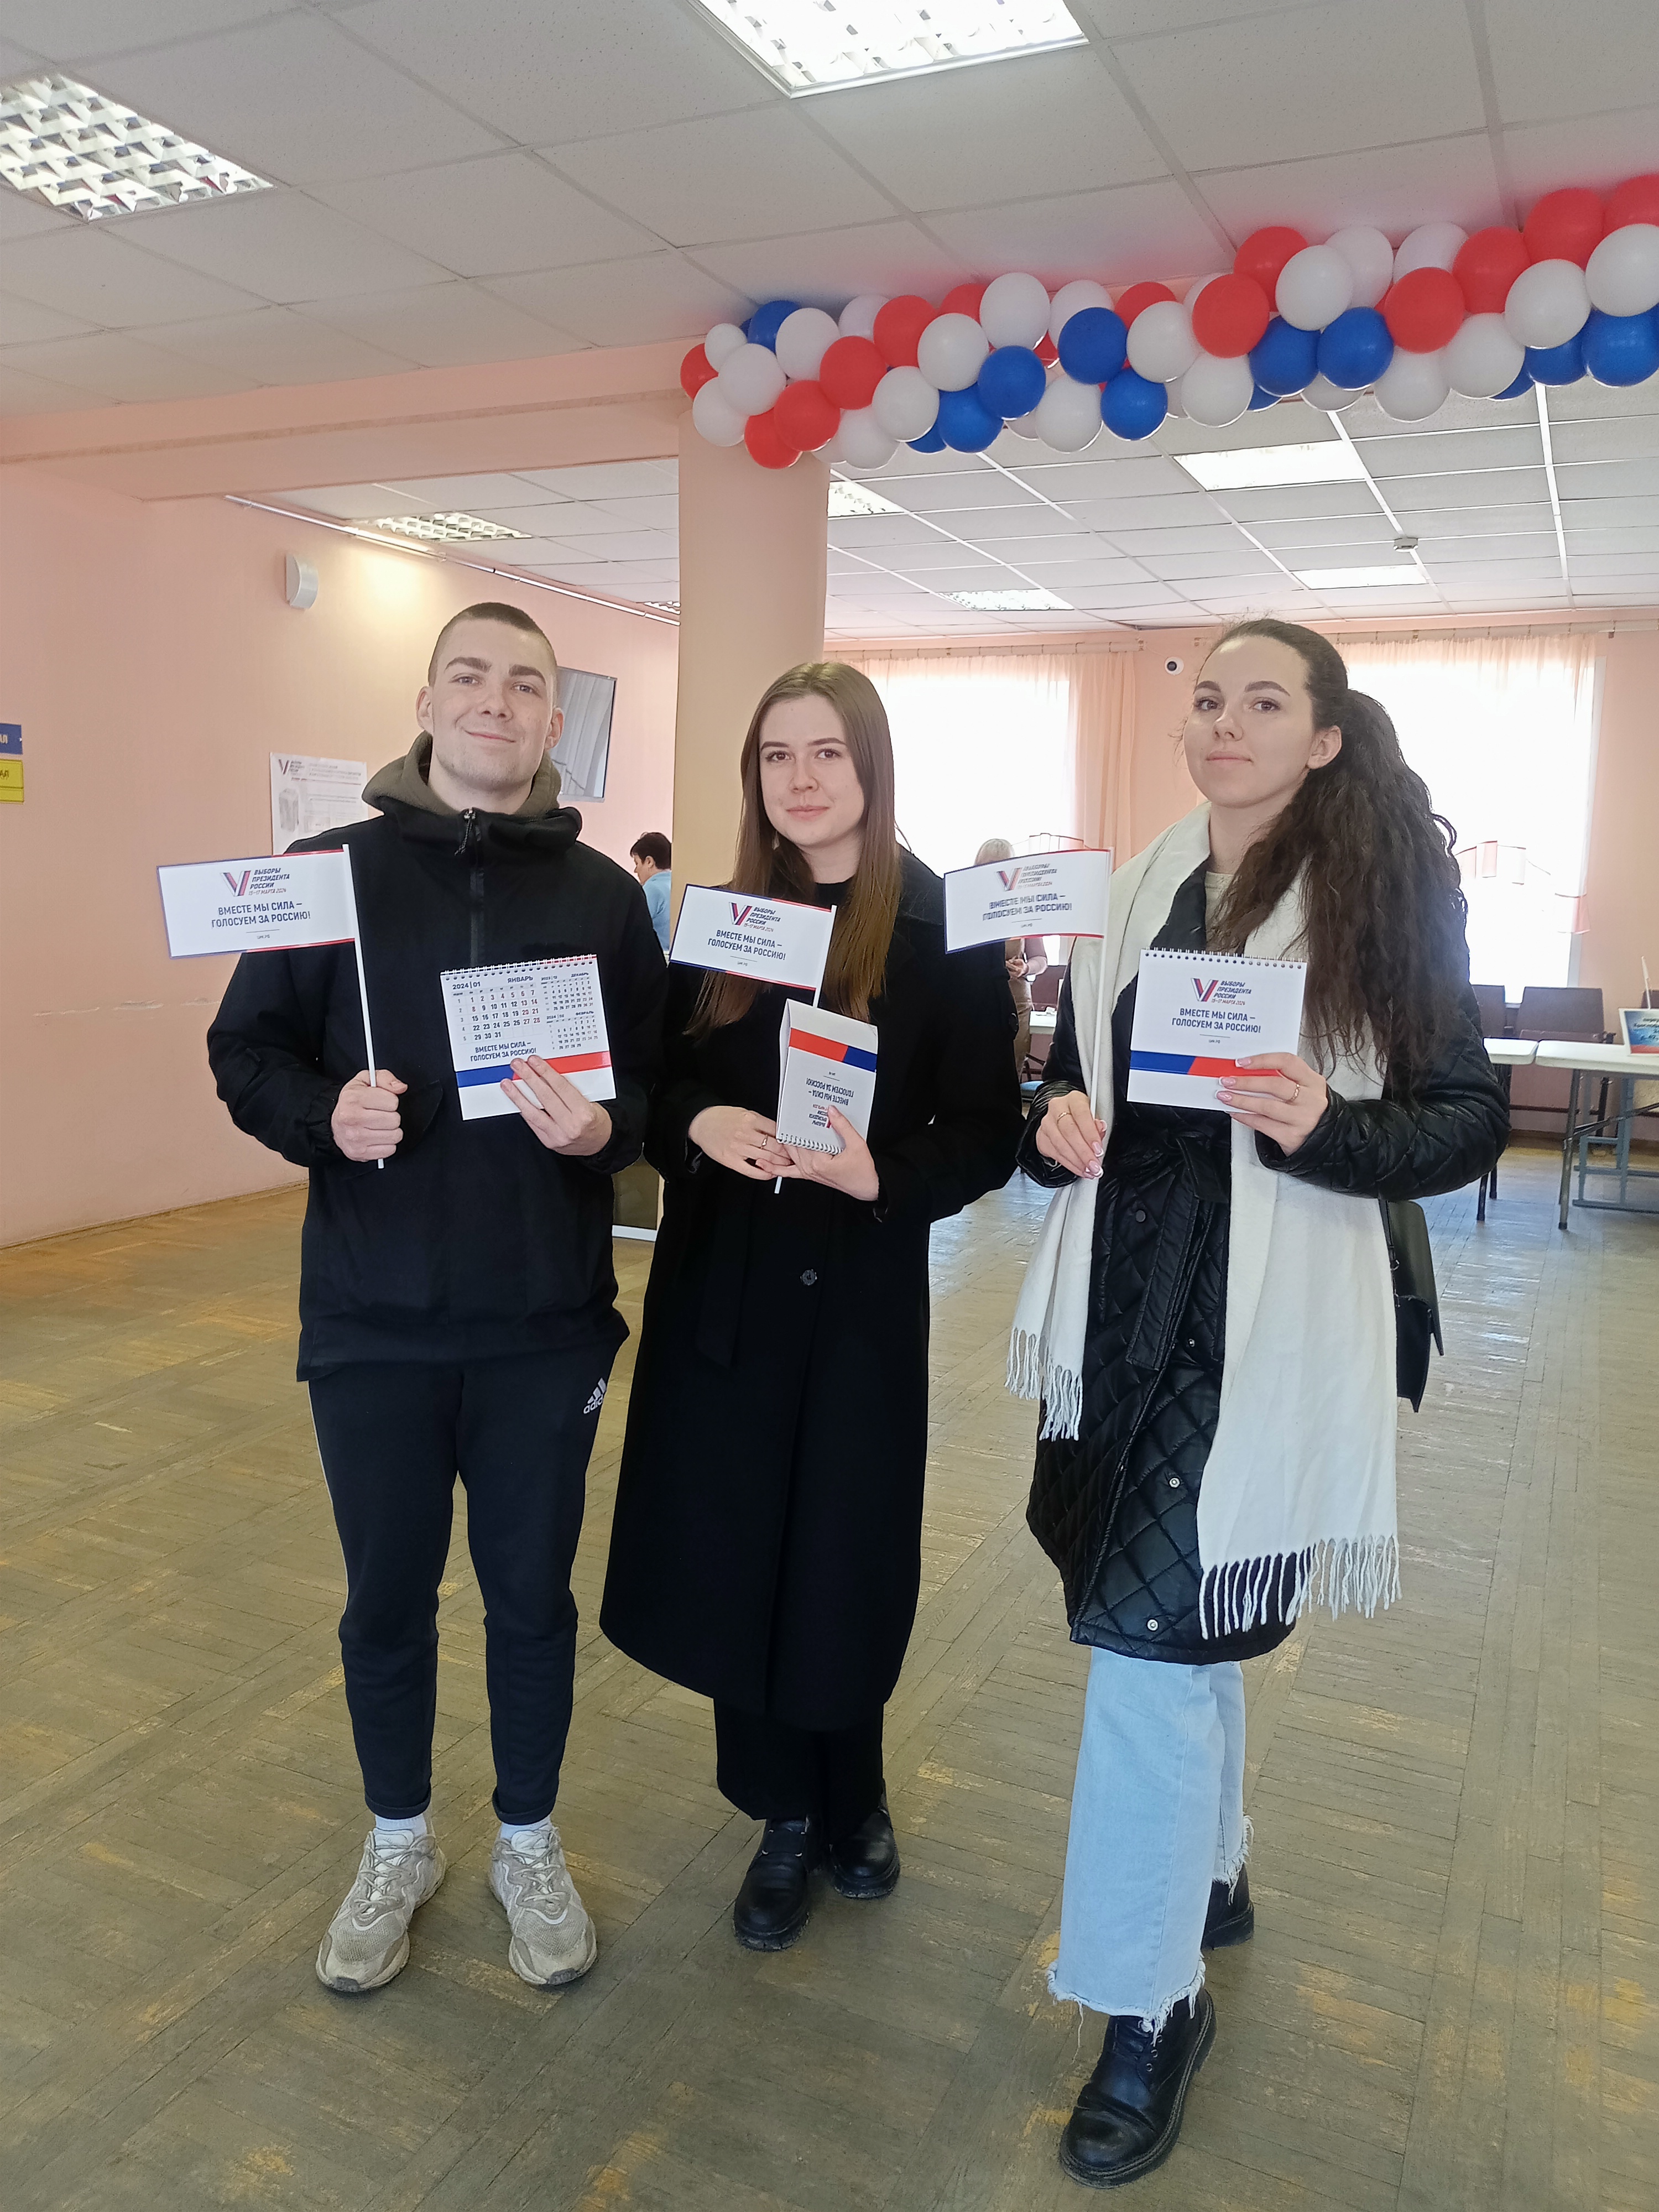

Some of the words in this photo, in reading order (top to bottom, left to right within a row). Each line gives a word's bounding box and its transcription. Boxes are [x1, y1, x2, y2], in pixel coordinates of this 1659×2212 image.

[989, 898, 1019, 909] ВМЕСТЕ
[1036, 893, 1058, 901] СИЛА
[218, 905, 252, 915] ВМЕСТЕ
[254, 903, 269, 912] МЫ
[272, 901, 294, 910] СИЛА
[983, 907, 1022, 921] ГОЛОСУЕМ
[1035, 902, 1072, 912] РОССИЮ!
[211, 916, 256, 927] ГОЛОСУЕМ
[271, 911, 311, 922] РОССИЮ!
[750, 912, 781, 922] ПРЕЗИДЕНТА
[716, 930, 742, 941] ВМЕСТЕ
[743, 935, 755, 943] МЫ
[757, 938, 775, 948] СИЛА
[708, 938, 742, 951] ГОЛОСУЕМ
[743, 945, 752, 953] ЗА
[753, 947, 786, 960] РОССИЮ!
[1180, 1008, 1210, 1018] ВМЕСТЕ
[1211, 1011, 1225, 1019] МЫ
[1227, 1012, 1248, 1021] СИЛА
[1172, 1018, 1212, 1029] ГОЛОСУЕМ
[1225, 1022, 1261, 1033] РОССИЮ!
[471, 1052, 500, 1061] ГОЛОСУЕМ
[510, 1048, 536, 1056] РОССИЮ!
[475, 1045, 498, 1053] ВМЕСТЕ
[806, 1078, 825, 1089] РОССИЮ!
[812, 1089, 823, 1099] СИЛА
[824, 1093, 832, 1101] МЫ
[832, 1085, 854, 1098] ГОЛОСУЕМ
[832, 1095, 849, 1105] ВМЕСТЕ
